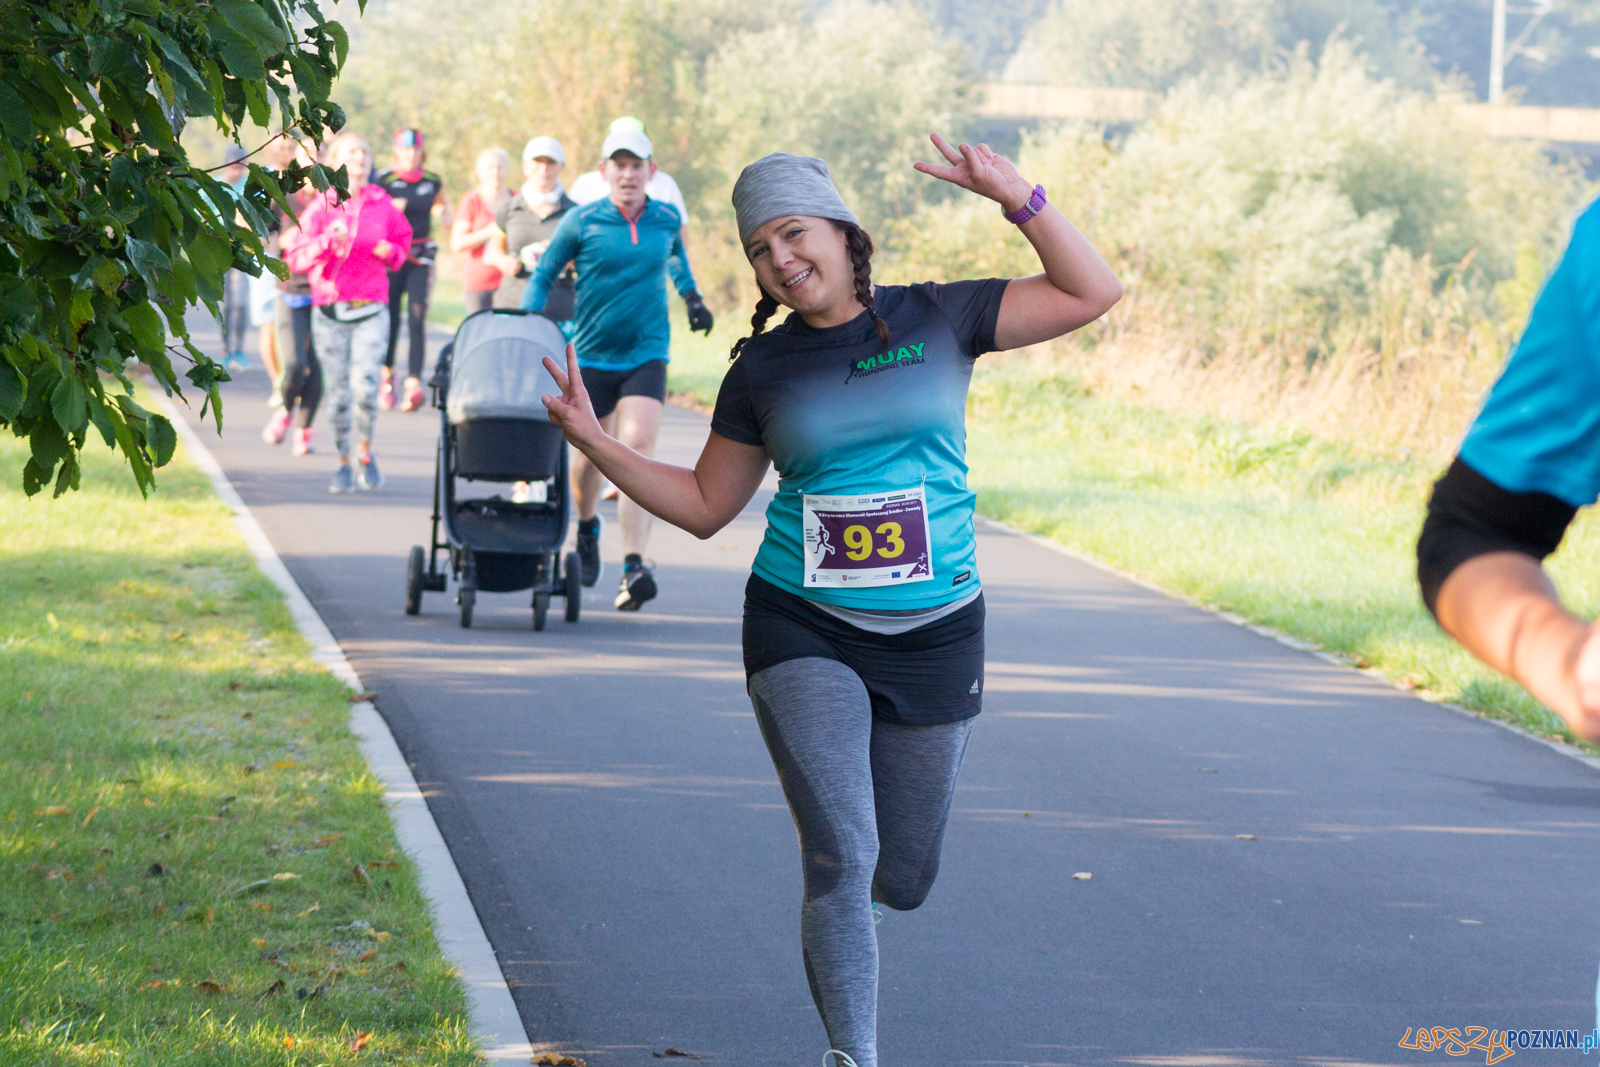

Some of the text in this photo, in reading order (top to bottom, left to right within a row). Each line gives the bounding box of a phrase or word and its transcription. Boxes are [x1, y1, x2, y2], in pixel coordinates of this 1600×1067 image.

[856, 341, 926, 371] MUAY
[859, 358, 925, 379] RUNNING TEAM
[843, 522, 905, 561] 93
